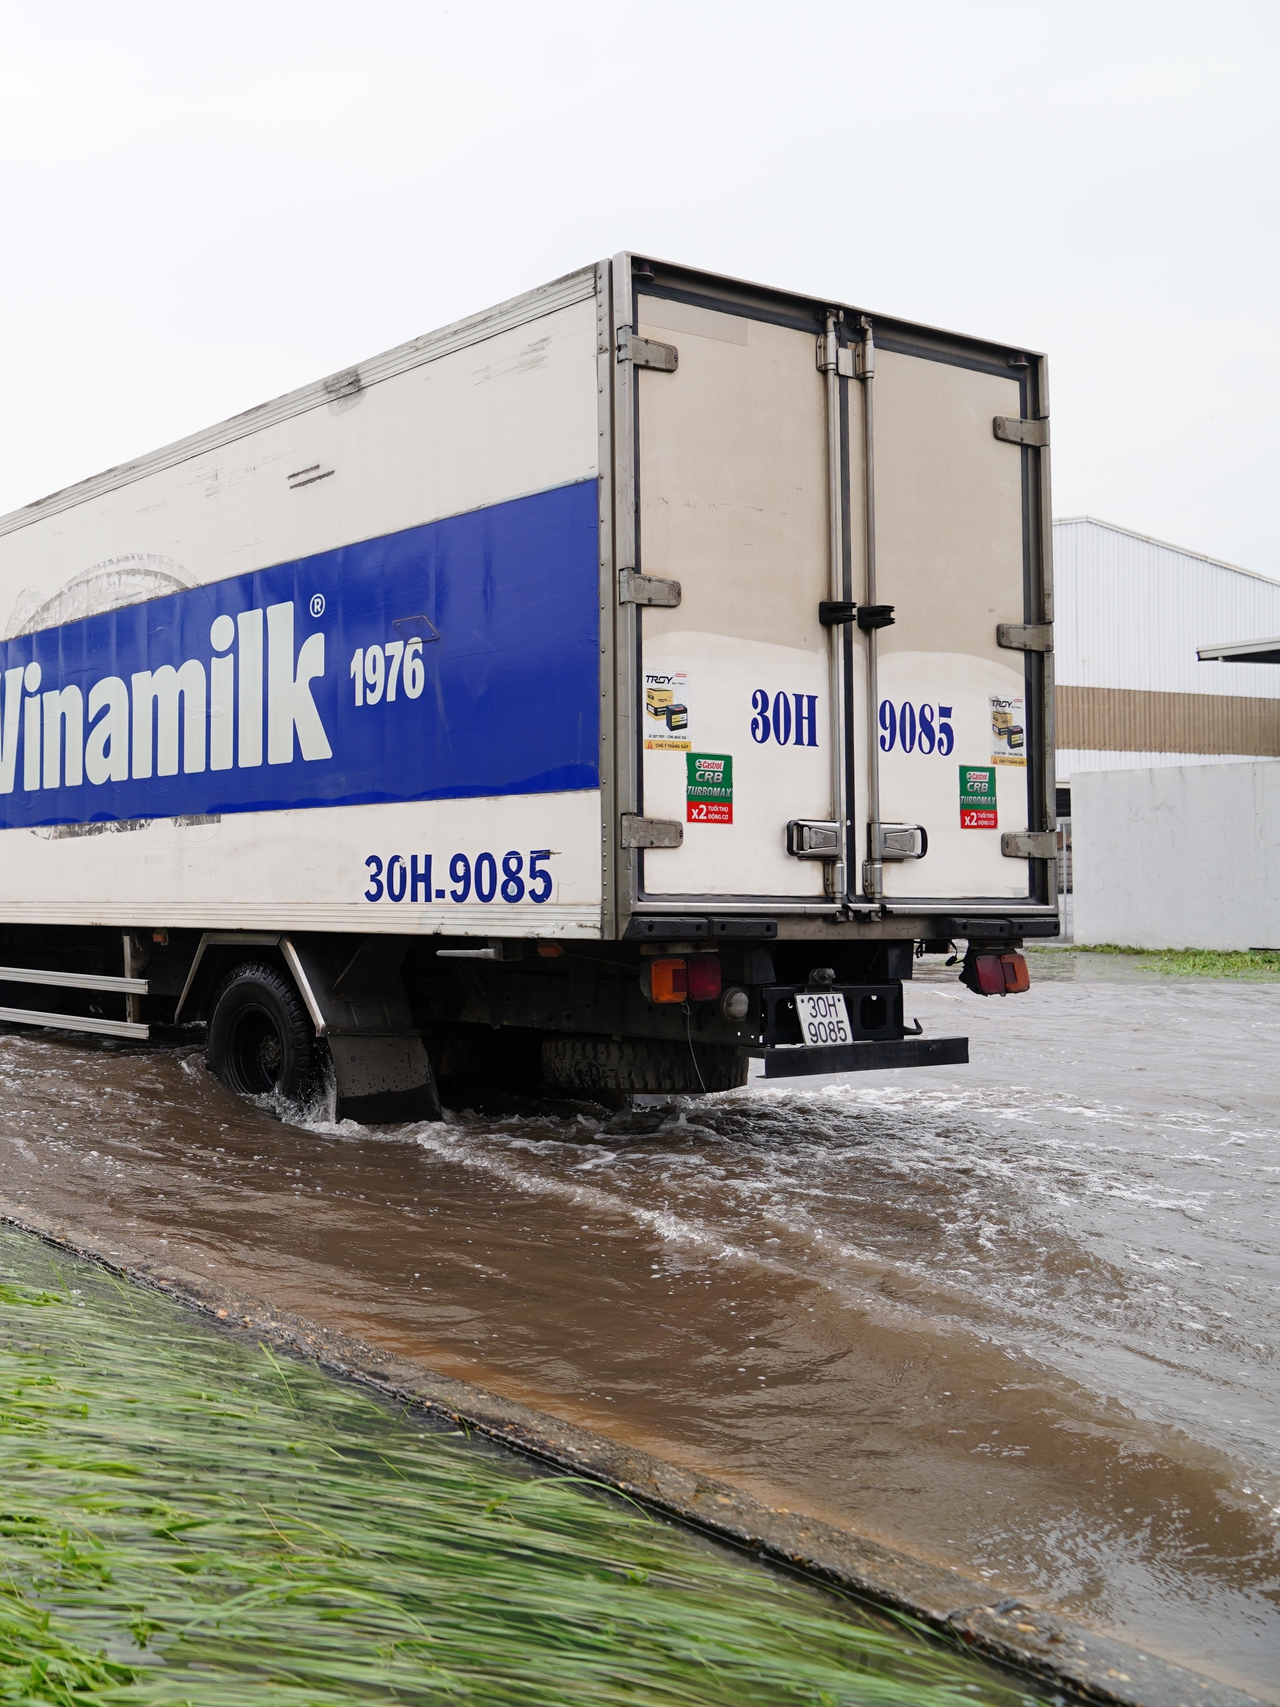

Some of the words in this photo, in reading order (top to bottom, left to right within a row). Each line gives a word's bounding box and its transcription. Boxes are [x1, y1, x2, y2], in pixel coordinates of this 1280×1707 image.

[350, 637, 425, 707] 1976
[645, 674, 674, 685] TROY
[991, 699, 1012, 708] TROY
[750, 688, 819, 747] 30H
[878, 699, 955, 757] 9085
[702, 760, 722, 770] Castrol
[695, 771, 724, 784] CRB
[971, 772, 988, 781] Castrol
[687, 785, 732, 798] TURBOMAX
[966, 782, 989, 793] CRB
[960, 795, 996, 805] TURBOMAX
[691, 804, 707, 820] x2
[964, 811, 978, 826] x2
[363, 849, 553, 904] 30H.9085
[807, 995, 838, 1019] 30H
[808, 1020, 847, 1044] 9085
